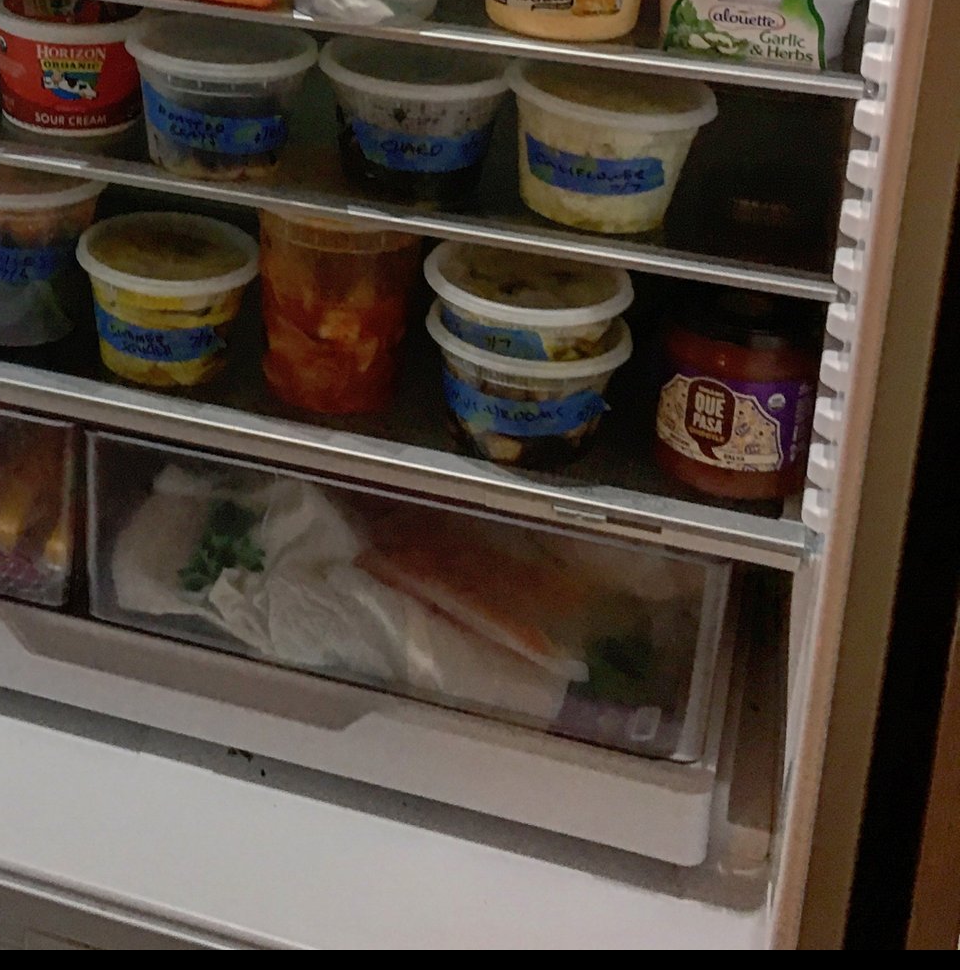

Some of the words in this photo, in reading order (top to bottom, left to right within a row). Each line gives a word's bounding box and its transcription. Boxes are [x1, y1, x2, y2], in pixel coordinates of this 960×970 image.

[713, 7, 777, 28] alouette
[759, 30, 807, 50] Garlic
[36, 43, 107, 60] HORIZON
[749, 44, 764, 58] &
[767, 46, 815, 63] Herbs
[43, 60, 99, 70] ORGANIC
[34, 111, 65, 126] SOUR
[68, 114, 107, 127] CREAM
[694, 390, 726, 419] QUE
[692, 411, 723, 435] PASA
